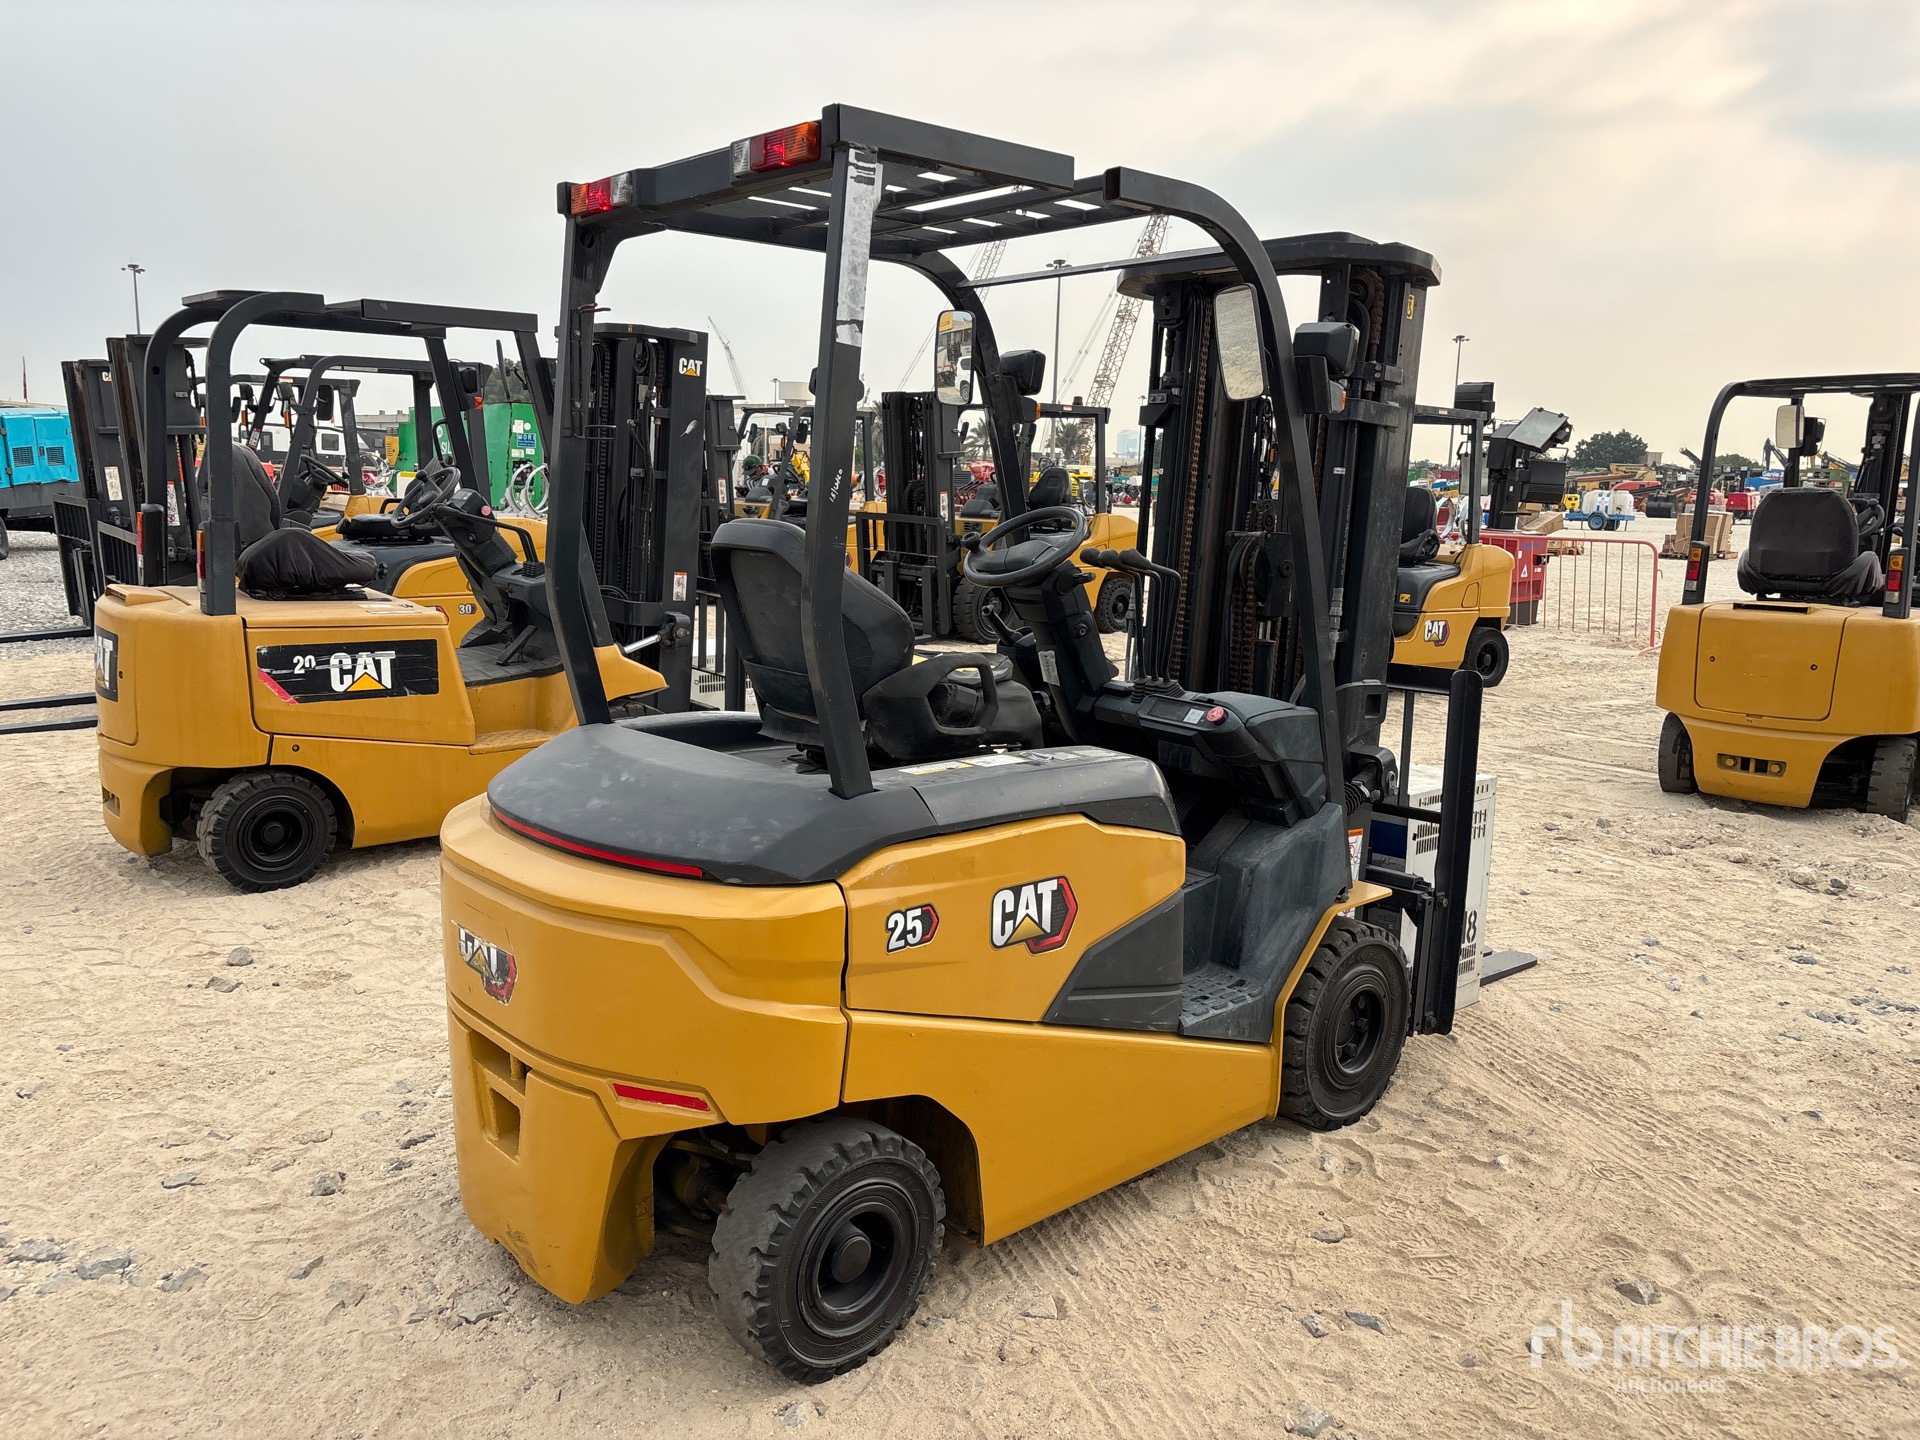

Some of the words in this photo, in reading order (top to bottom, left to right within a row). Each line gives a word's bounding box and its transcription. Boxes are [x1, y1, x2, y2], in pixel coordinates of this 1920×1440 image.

[678, 357, 703, 377] CAT
[1762, 470, 1780, 478] Genie
[458, 604, 472, 615] 30
[1424, 619, 1446, 642] CAT
[95, 634, 114, 691] AT
[329, 650, 396, 692] CAT
[991, 878, 1058, 947] CAT
[887, 907, 923, 951] 25
